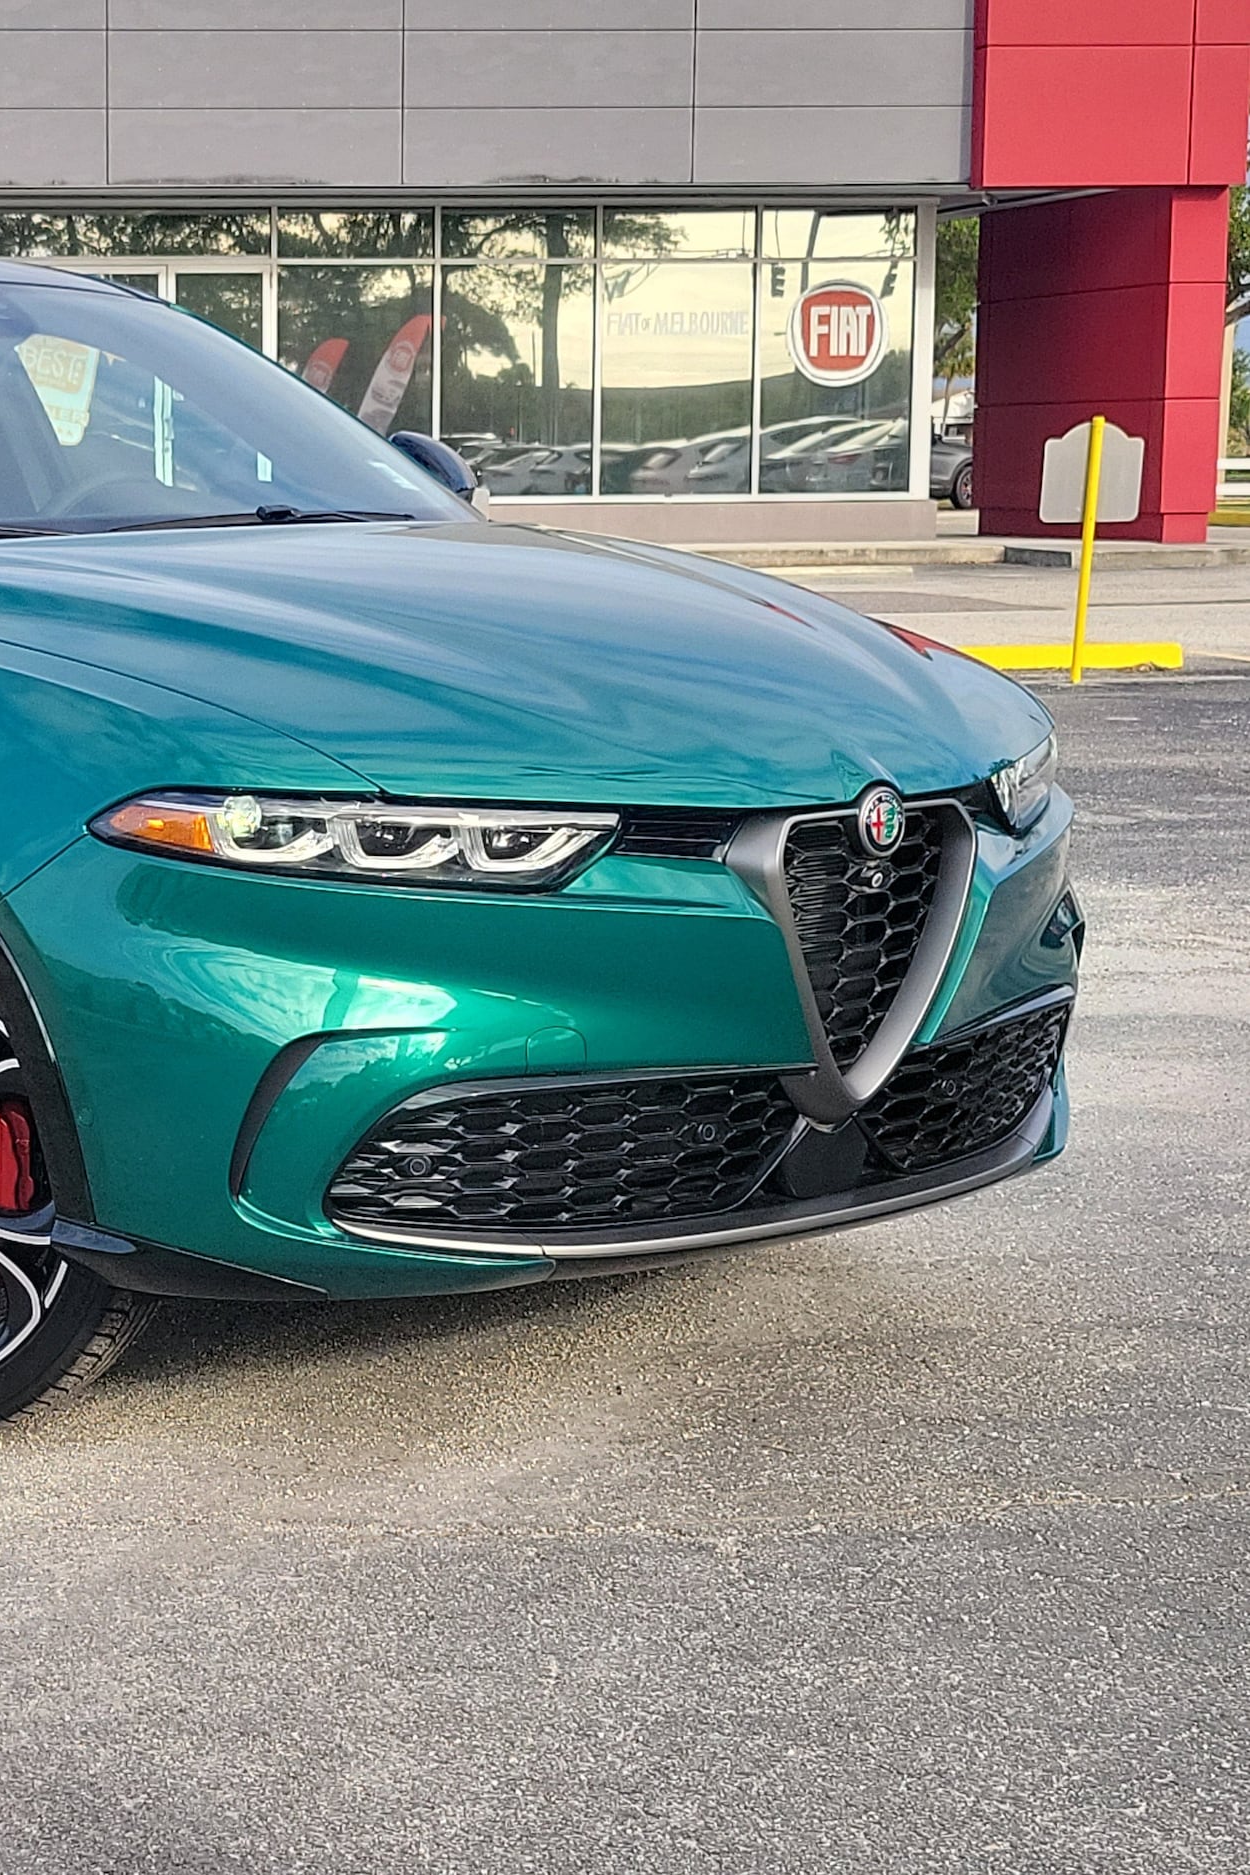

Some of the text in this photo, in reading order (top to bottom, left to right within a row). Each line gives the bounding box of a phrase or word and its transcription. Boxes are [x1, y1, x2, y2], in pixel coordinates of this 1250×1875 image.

[607, 312, 641, 336] FIAT
[654, 311, 749, 336] MELBOURNE
[809, 304, 872, 357] FIAT
